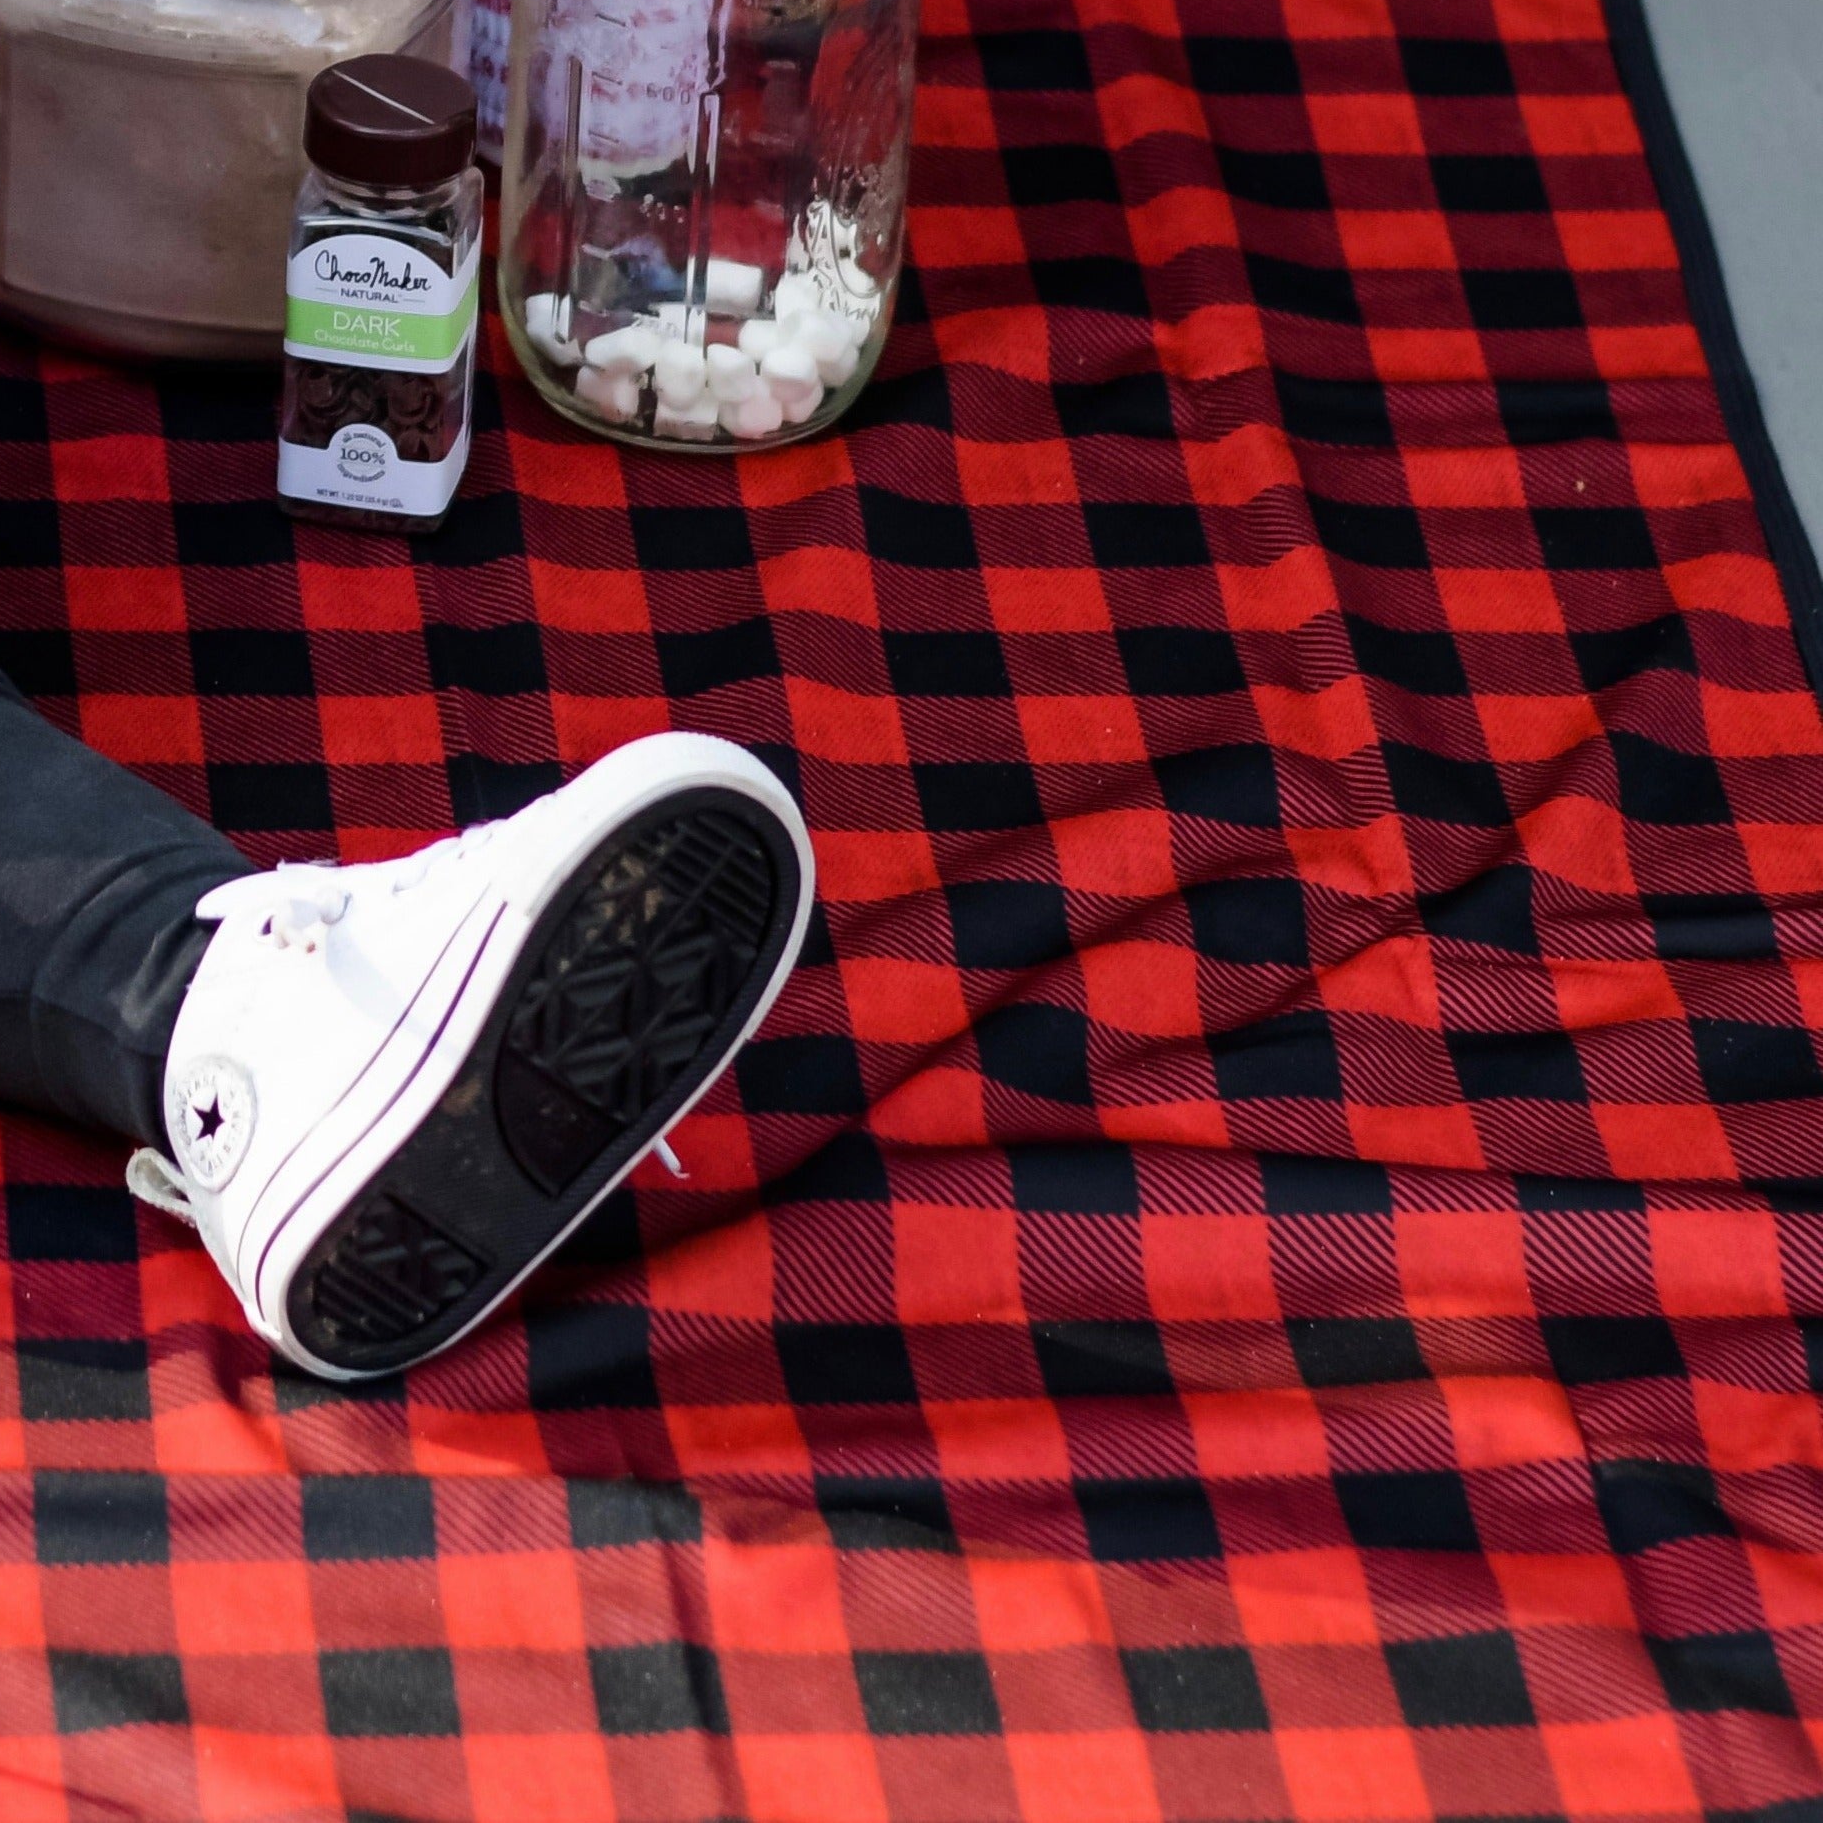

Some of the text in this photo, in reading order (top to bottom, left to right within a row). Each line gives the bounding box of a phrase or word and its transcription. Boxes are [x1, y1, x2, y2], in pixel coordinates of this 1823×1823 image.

[315, 249, 432, 291] ChocoMaker
[340, 287, 399, 304] NATURAL
[333, 311, 402, 337] DARK
[314, 328, 416, 353] Chocolate Curls
[353, 433, 386, 448] natural
[340, 448, 385, 465] 100%
